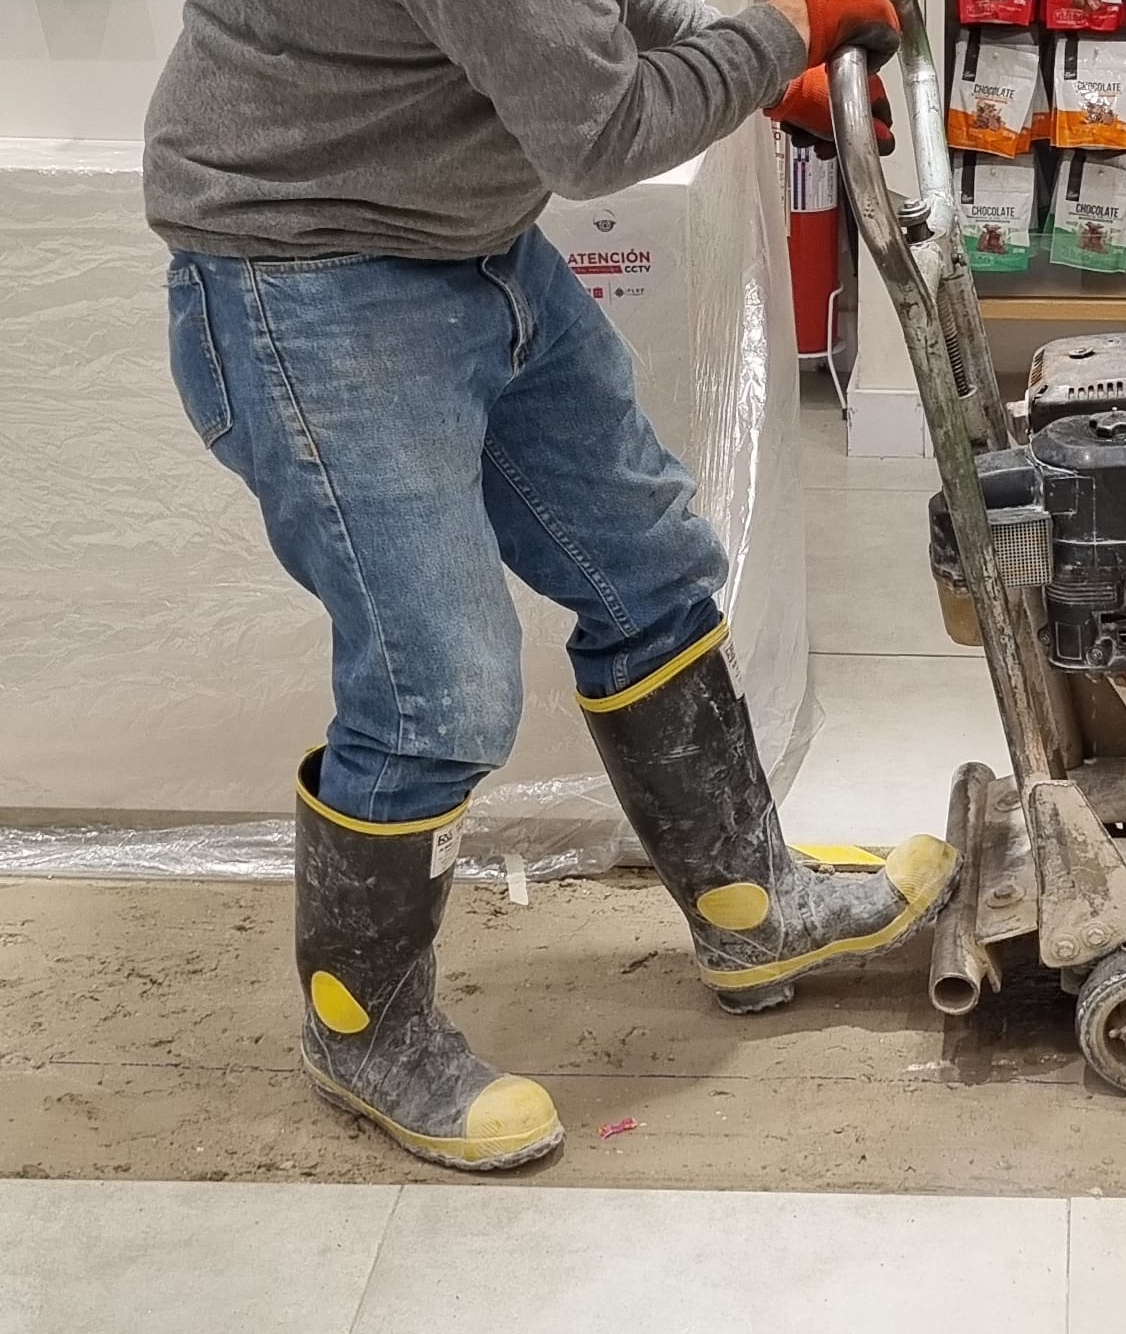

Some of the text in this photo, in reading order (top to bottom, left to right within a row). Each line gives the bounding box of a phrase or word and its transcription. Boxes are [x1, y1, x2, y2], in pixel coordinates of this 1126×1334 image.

[973, 83, 1016, 100] CHOCOLATE
[1077, 81, 1121, 93] CHOCOLATE
[971, 206, 1015, 217] CHOCOLATE
[1076, 203, 1119, 219] CHOCOLATE
[568, 249, 650, 265] ATENCIÓN
[624, 265, 651, 273] CCTV
